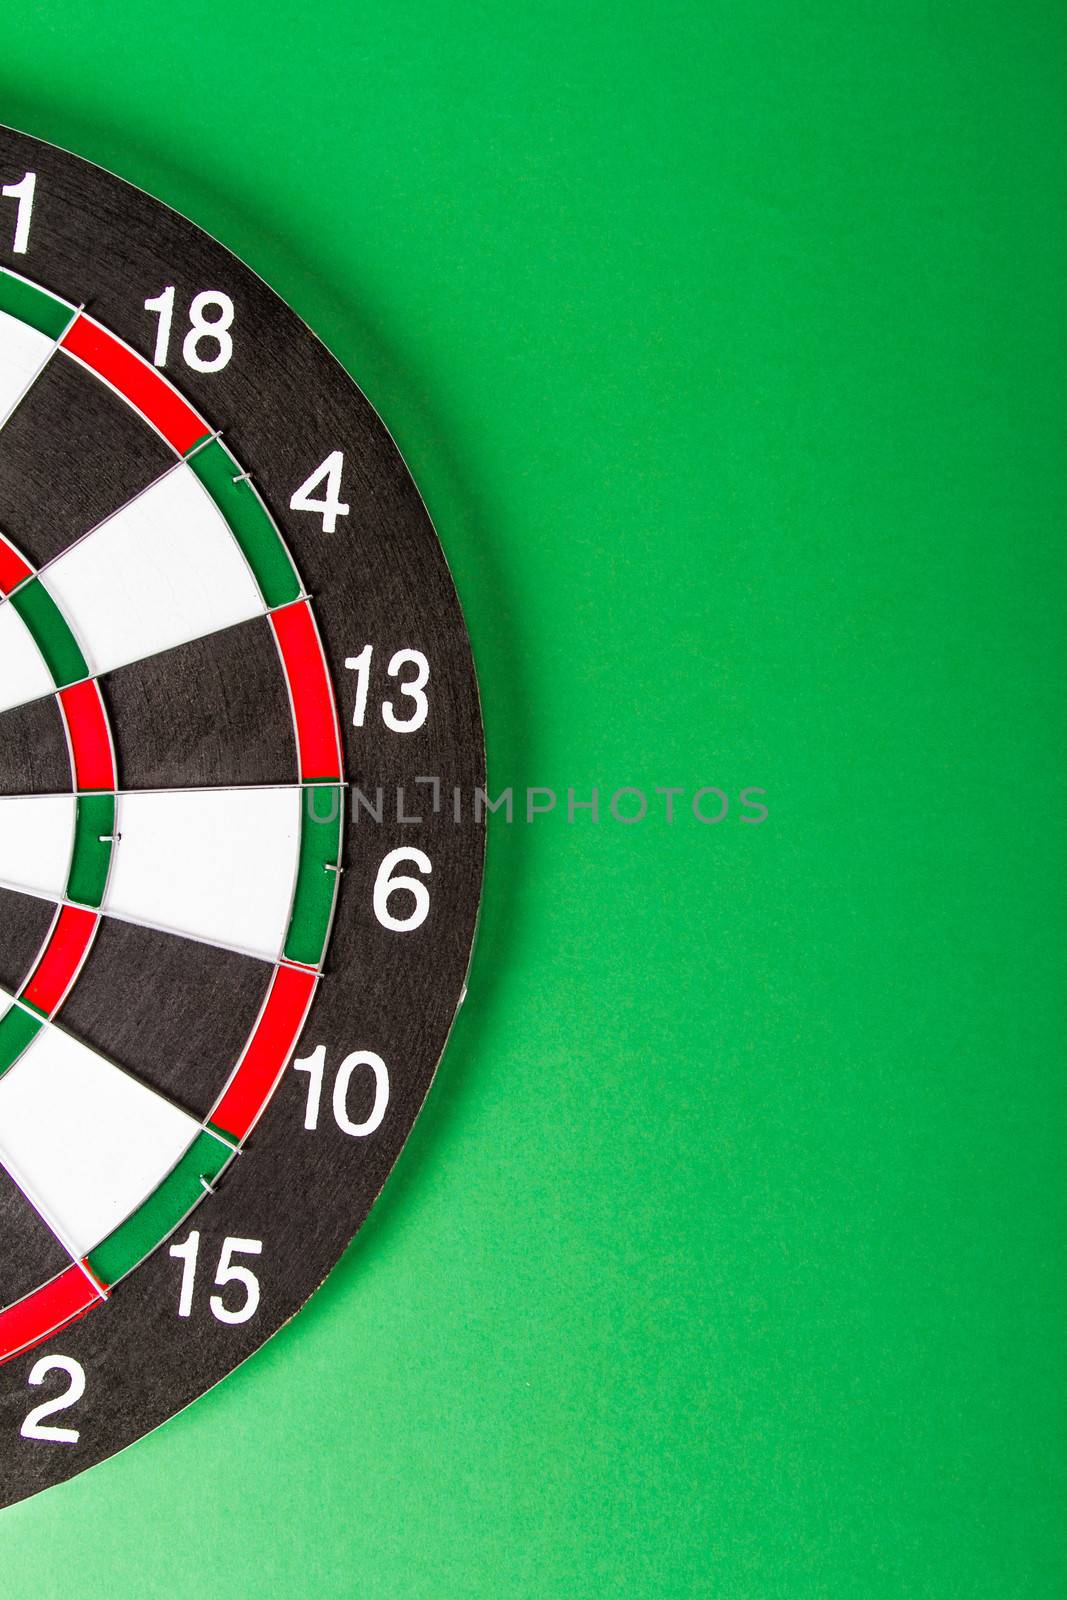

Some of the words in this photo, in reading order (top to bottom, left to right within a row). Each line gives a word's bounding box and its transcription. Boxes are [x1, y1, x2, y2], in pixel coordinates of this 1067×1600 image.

[2, 172, 36, 254] 1
[145, 287, 234, 373] 18
[290, 451, 349, 533] 4
[345, 645, 430, 733] 13
[373, 847, 432, 932] 6
[294, 1045, 389, 1136] 10
[170, 1231, 262, 1324] 15
[21, 1355, 85, 1443] 2
